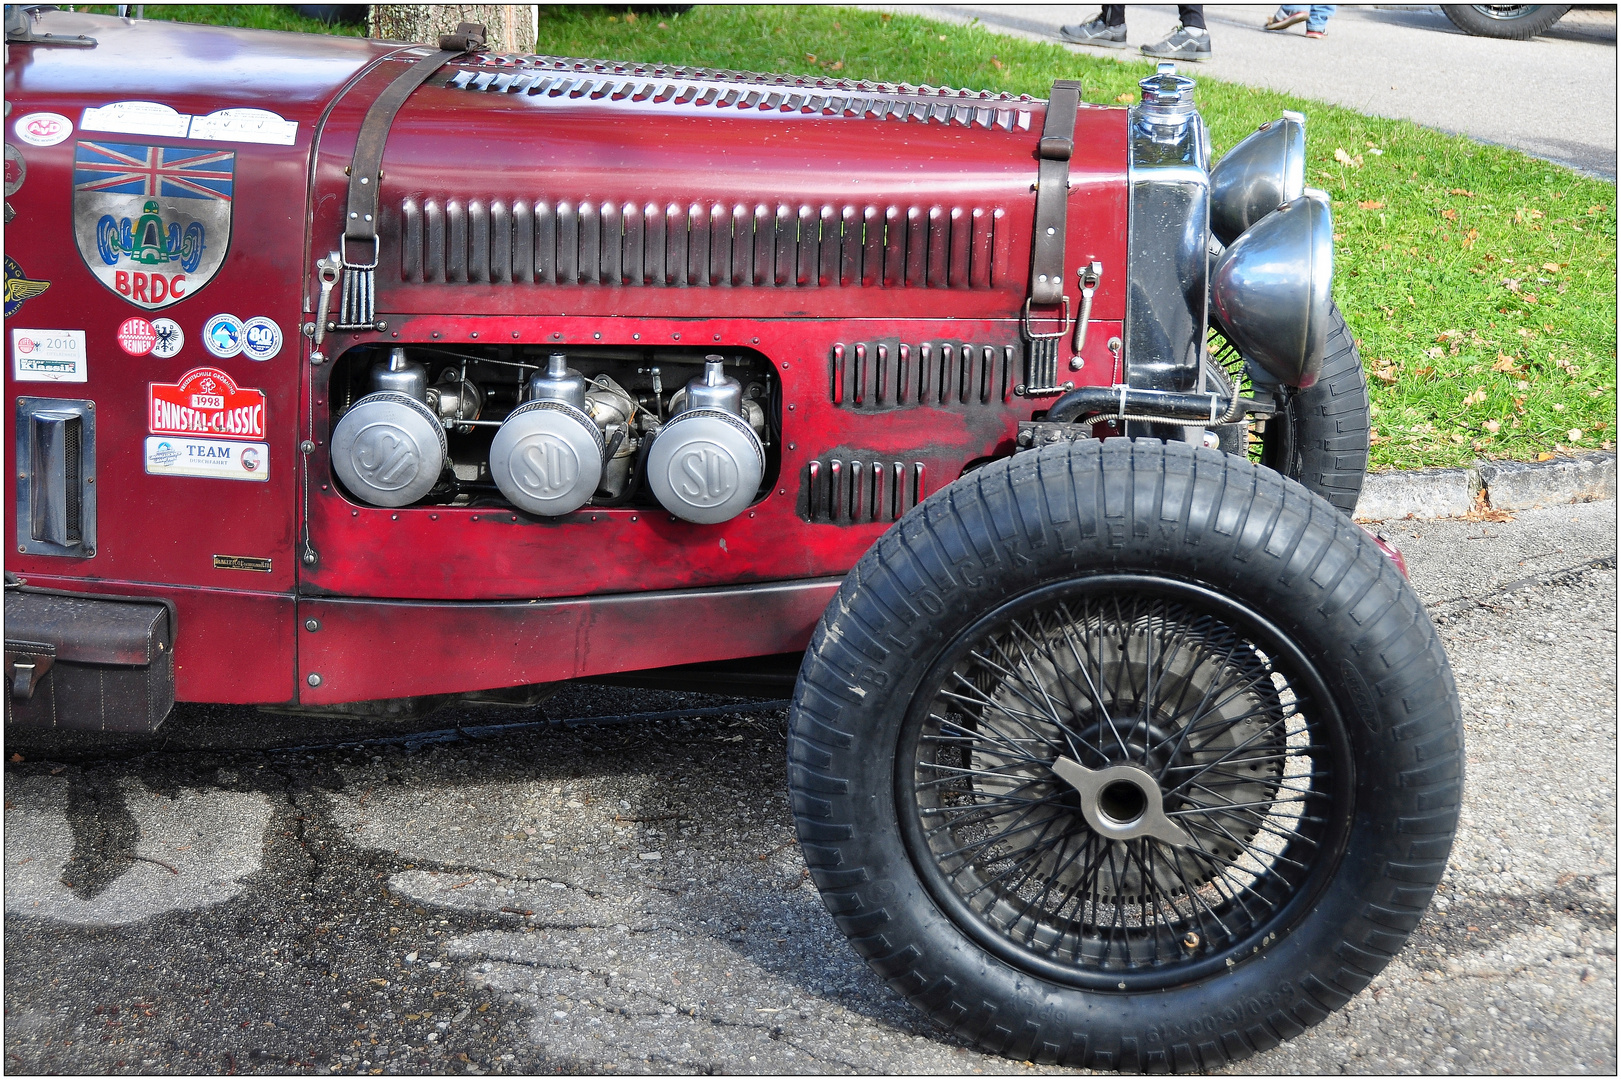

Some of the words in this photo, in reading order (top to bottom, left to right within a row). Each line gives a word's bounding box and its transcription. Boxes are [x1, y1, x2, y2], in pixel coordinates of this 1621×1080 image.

[115, 270, 186, 303] BRDC
[123, 319, 151, 335] EIFEL
[249, 327, 272, 341] 80
[46, 338, 76, 350] 2010
[123, 339, 151, 353] RENNEN
[20, 362, 75, 373] Klassik
[197, 396, 220, 406] 1998
[154, 398, 262, 434] ENNSTAL-CLASSIC
[186, 445, 231, 458] TEAM
[861, 520, 1180, 692] BLOCKLEY
